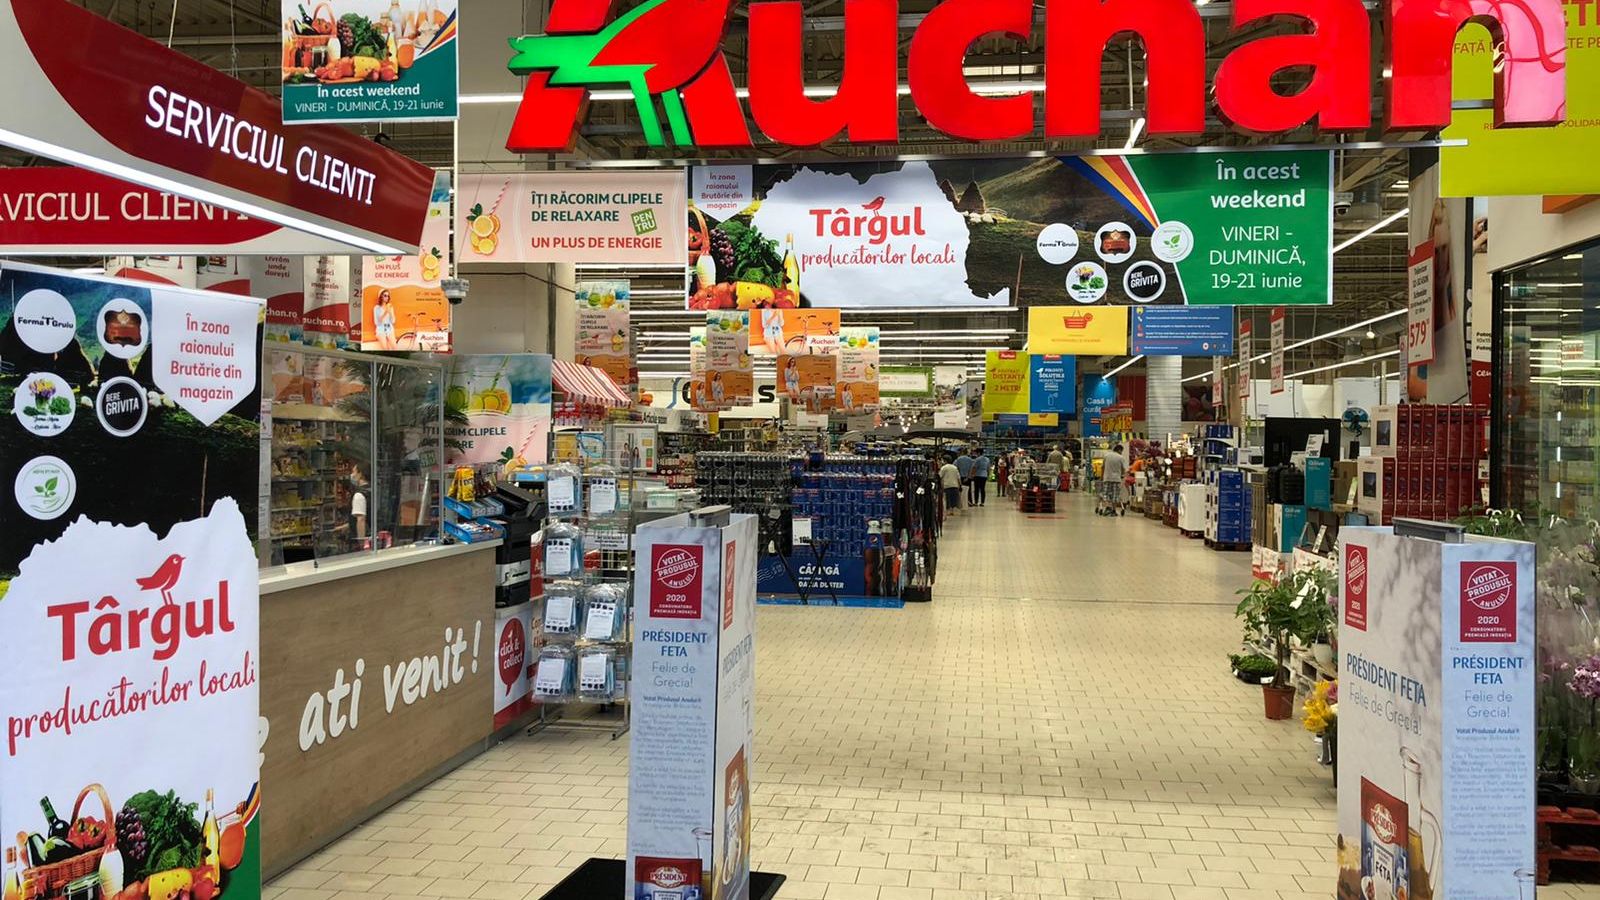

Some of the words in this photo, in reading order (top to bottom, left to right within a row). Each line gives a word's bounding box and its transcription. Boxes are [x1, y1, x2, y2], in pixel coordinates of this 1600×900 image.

[1567, 37, 1583, 49] TE
[318, 84, 328, 98] În
[332, 86, 363, 97] acest
[366, 83, 420, 96] weekend
[295, 102, 327, 113] VINERI
[337, 99, 391, 112] DUMINICĂ,
[393, 100, 418, 110] 19-21
[421, 99, 444, 109] iunie
[145, 85, 288, 175] SERVICIUL
[295, 145, 376, 204] CLIENTI
[1216, 159, 1236, 180] În
[1244, 163, 1300, 180] acest
[706, 182, 739, 190] raionului
[531, 190, 547, 208] ÎȚI
[550, 190, 610, 204] RĂCORIM
[612, 192, 663, 205] CLIPELE
[731, 191, 743, 199] din
[1211, 189, 1305, 209] weekend
[0, 192, 110, 221] VICIUL
[706, 201, 738, 211] magazin
[531, 210, 548, 222] DE
[551, 210, 619, 222] RELAXARE
[632, 211, 653, 224] PEN
[635, 220, 656, 232] TRU
[809, 206, 925, 244] Târgul
[1221, 226, 1279, 242] VINERI
[531, 237, 551, 248] UN
[553, 237, 585, 248] PLUS
[588, 237, 605, 248] DE
[608, 237, 663, 248] ENERGIE
[801, 243, 907, 273] producătorilor
[911, 242, 957, 265] locali
[1209, 245, 1305, 266] DUMINICĂ,
[1211, 273, 1255, 288] 19-21
[1262, 272, 1302, 288] iunie
[266, 308, 298, 318] chan.ro
[18, 317, 44, 326] Ferma
[186, 313, 199, 334] În
[201, 322, 230, 335] zona
[1410, 322, 1427, 348] 579
[180, 339, 235, 358] raionului
[170, 360, 221, 379] Brutărie
[223, 363, 242, 379] din
[105, 392, 121, 402] BERE
[179, 383, 235, 402] magazin
[468, 427, 507, 437] CLIPELE
[662, 552, 686, 566] VOTAT
[657, 560, 698, 577] PRODUSUL
[669, 573, 694, 587] ANULUI
[1472, 569, 1498, 586] VOTAT
[1468, 577, 1511, 598] PRODUSUL
[666, 594, 686, 602] 2020
[1479, 593, 1506, 608] ANULUI
[47, 580, 235, 661] Târgul
[1477, 616, 1499, 625] 2020
[642, 629, 707, 644] PRÉSIDENT
[500, 638, 513, 656] click
[661, 646, 687, 657] FETA
[652, 661, 679, 673] Felie
[681, 661, 696, 673] de
[1453, 653, 1525, 669] PRÉSIDENT
[299, 658, 365, 751] ati
[383, 620, 481, 714] venit!
[654, 675, 693, 689] Grecia!
[1346, 652, 1398, 693] PRÉSIDENT
[1400, 676, 1427, 707] FETA
[1474, 672, 1503, 684] FETA
[8, 666, 193, 757] producătorilor
[199, 650, 256, 697] locali
[1464, 689, 1493, 703] Felie
[1496, 689, 1512, 703] de
[1350, 682, 1369, 707] Felie
[1371, 695, 1382, 717] de
[1385, 702, 1422, 737] Grecia!
[1467, 705, 1510, 719] Grecia!
[650, 871, 688, 882] PRÉSIDENT
[1375, 861, 1392, 884] FETA
